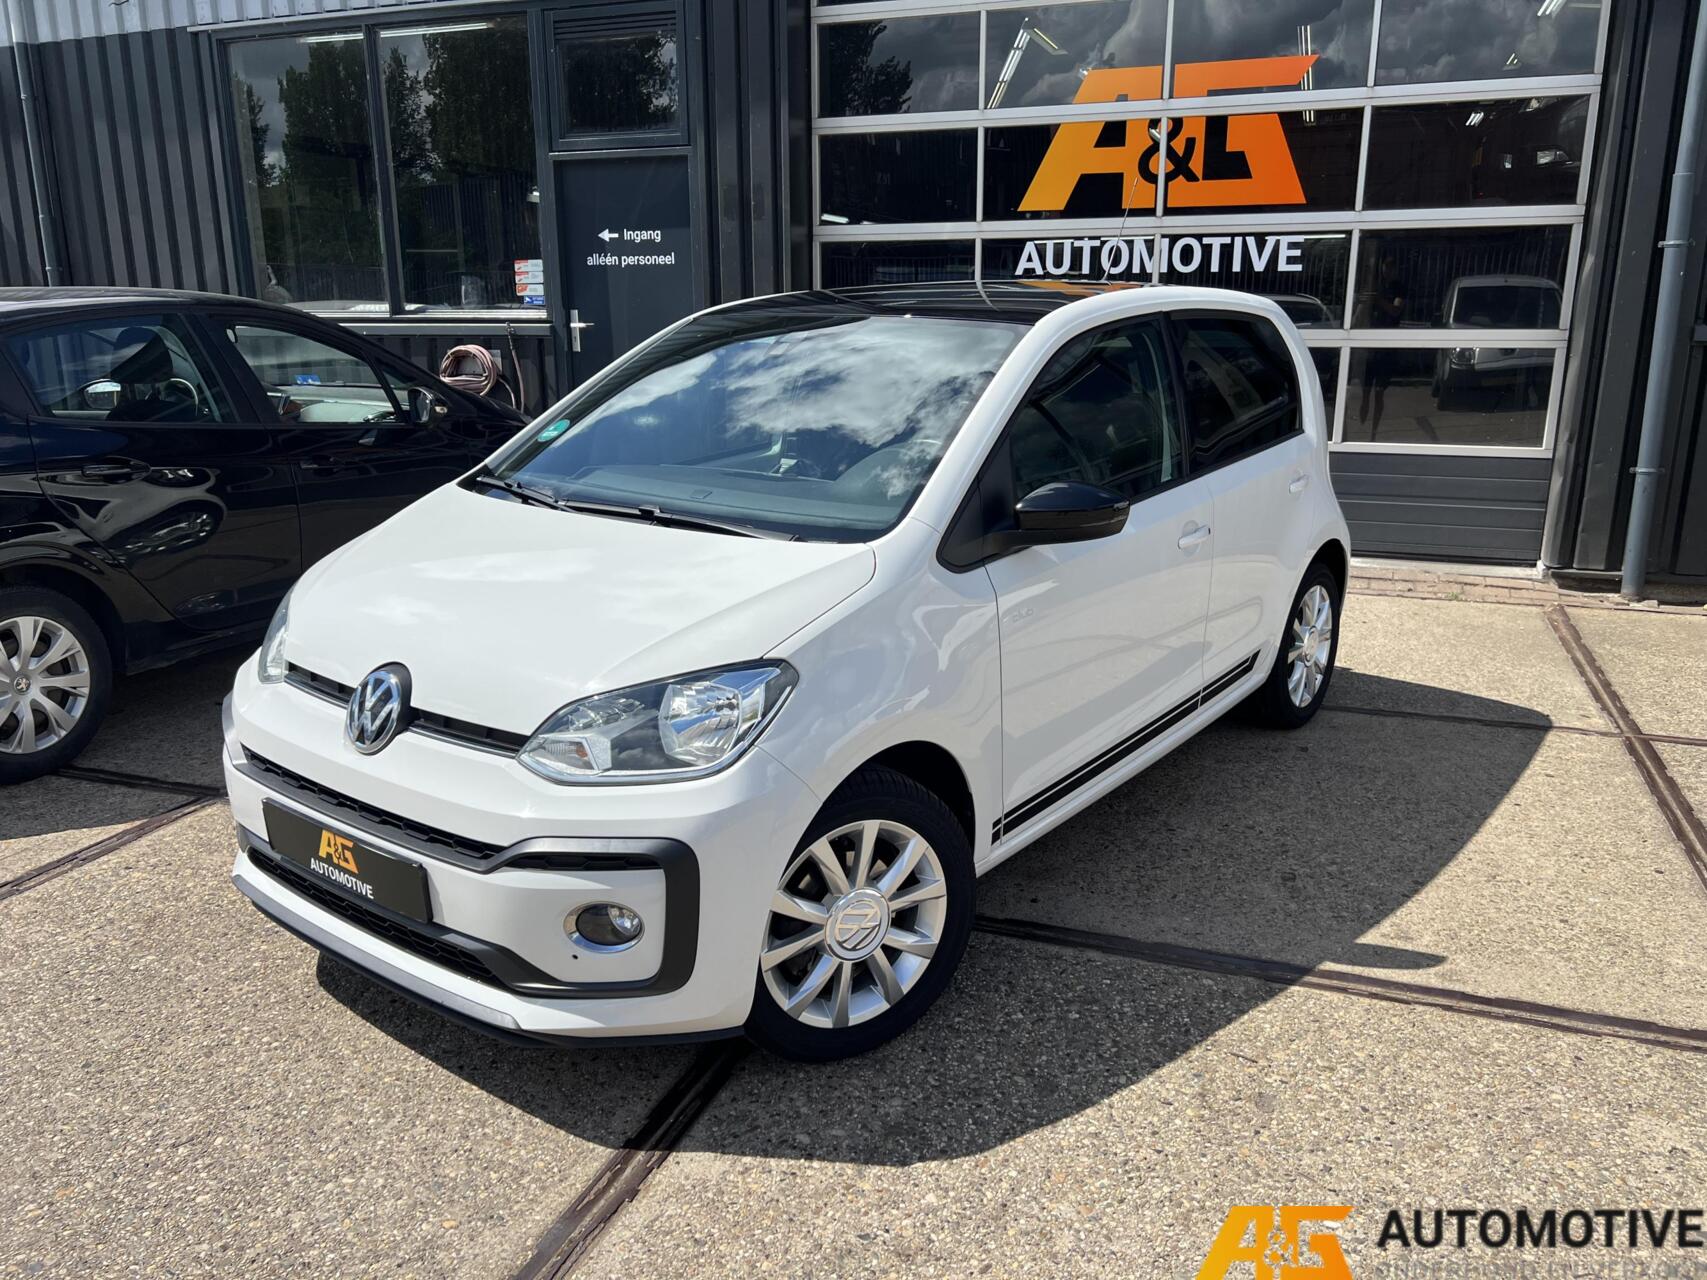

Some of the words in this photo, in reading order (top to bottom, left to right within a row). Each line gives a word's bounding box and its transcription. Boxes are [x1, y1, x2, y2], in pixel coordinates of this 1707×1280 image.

[623, 228, 662, 243] Ingang
[586, 253, 619, 266] alléén
[621, 252, 675, 268] personeel
[1014, 235, 1305, 276] AUTOMOTIVE
[310, 857, 375, 900] AUTOMOTIVE
